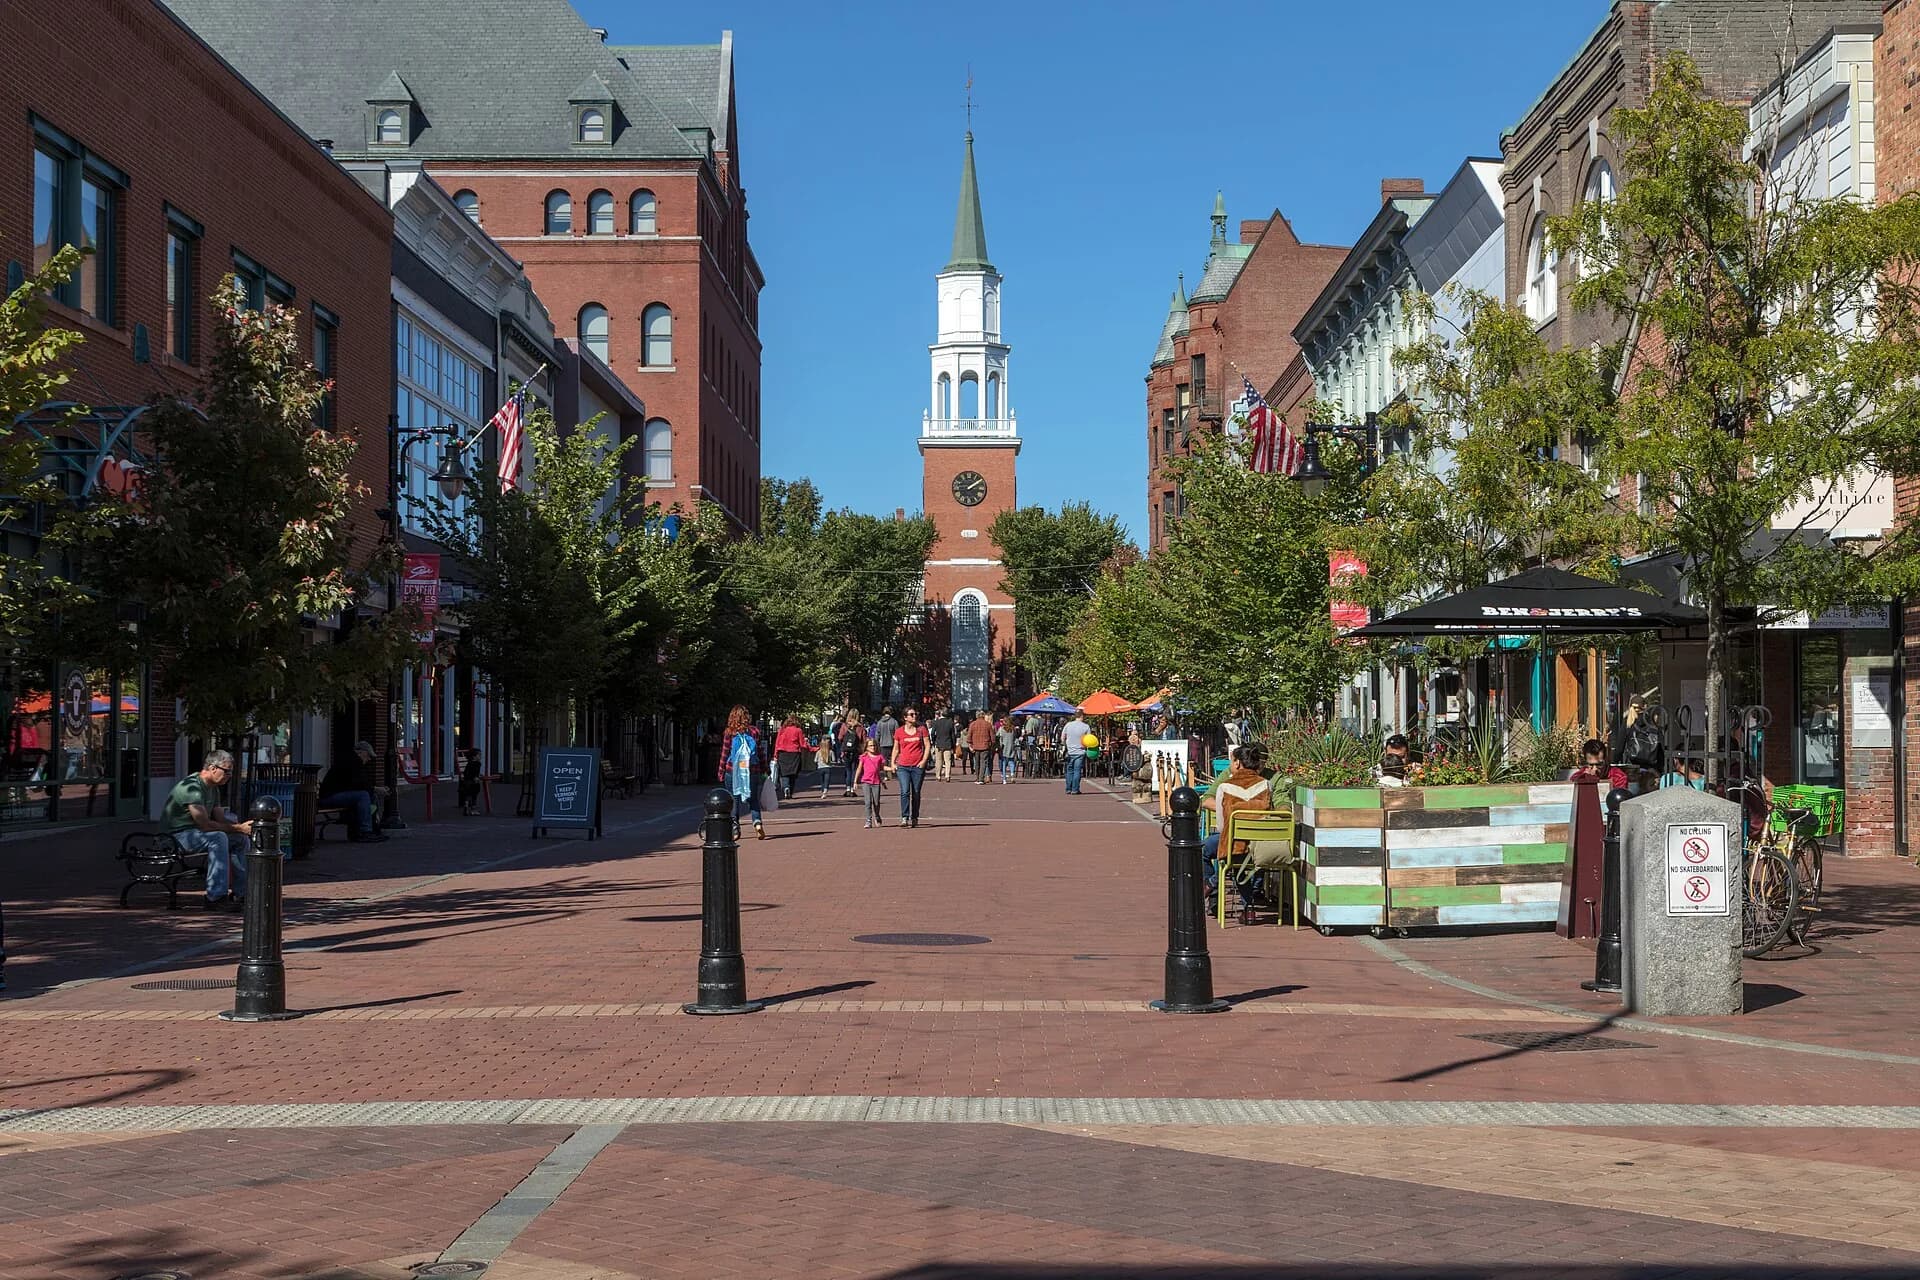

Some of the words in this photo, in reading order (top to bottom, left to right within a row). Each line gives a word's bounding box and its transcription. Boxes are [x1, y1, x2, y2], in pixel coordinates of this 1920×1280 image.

[552, 767, 583, 775] OPEN
[1680, 828, 1688, 836] NO
[1670, 865, 1679, 873] NO
[1680, 865, 1724, 873] SKATEBOARDING
